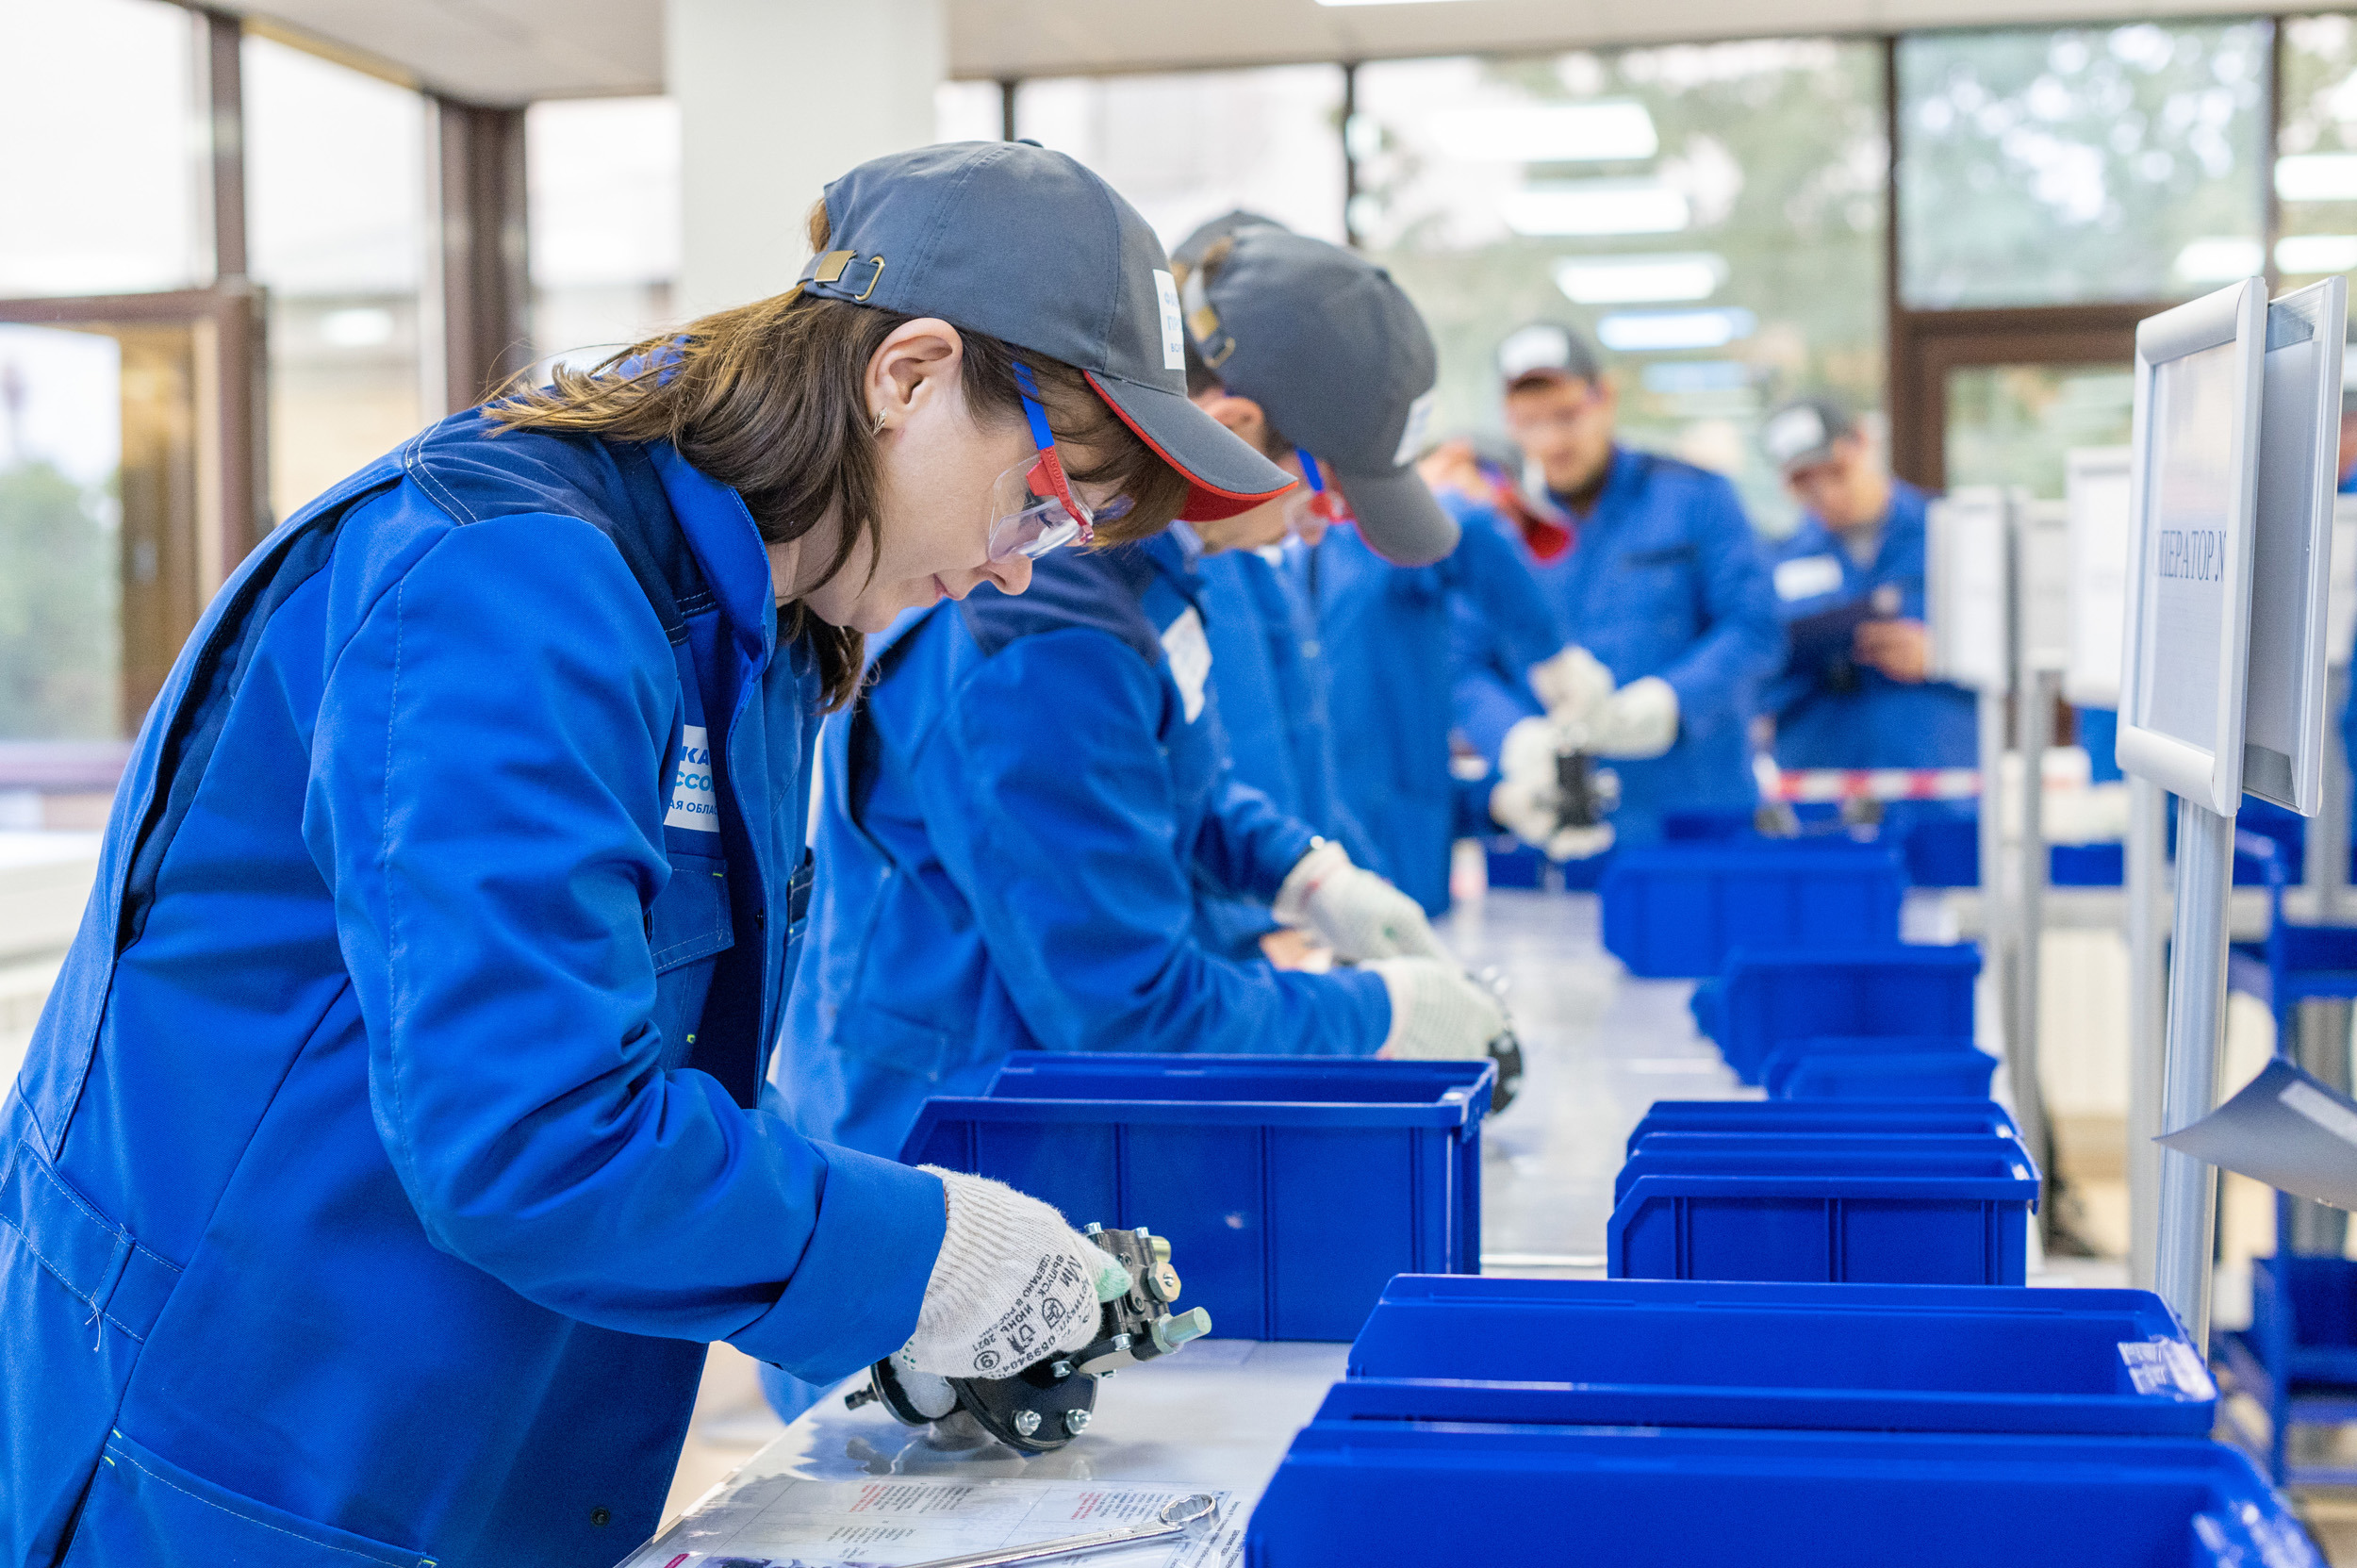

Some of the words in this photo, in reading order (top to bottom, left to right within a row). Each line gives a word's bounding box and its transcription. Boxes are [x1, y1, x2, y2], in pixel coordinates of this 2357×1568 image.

[2157, 530, 2214, 581] ПЕРАТОР
[1022, 1253, 1051, 1297] СДЕЛАНО
[1000, 1304, 1034, 1331] ИЮНЬ
[972, 1333, 997, 1352] 2021
